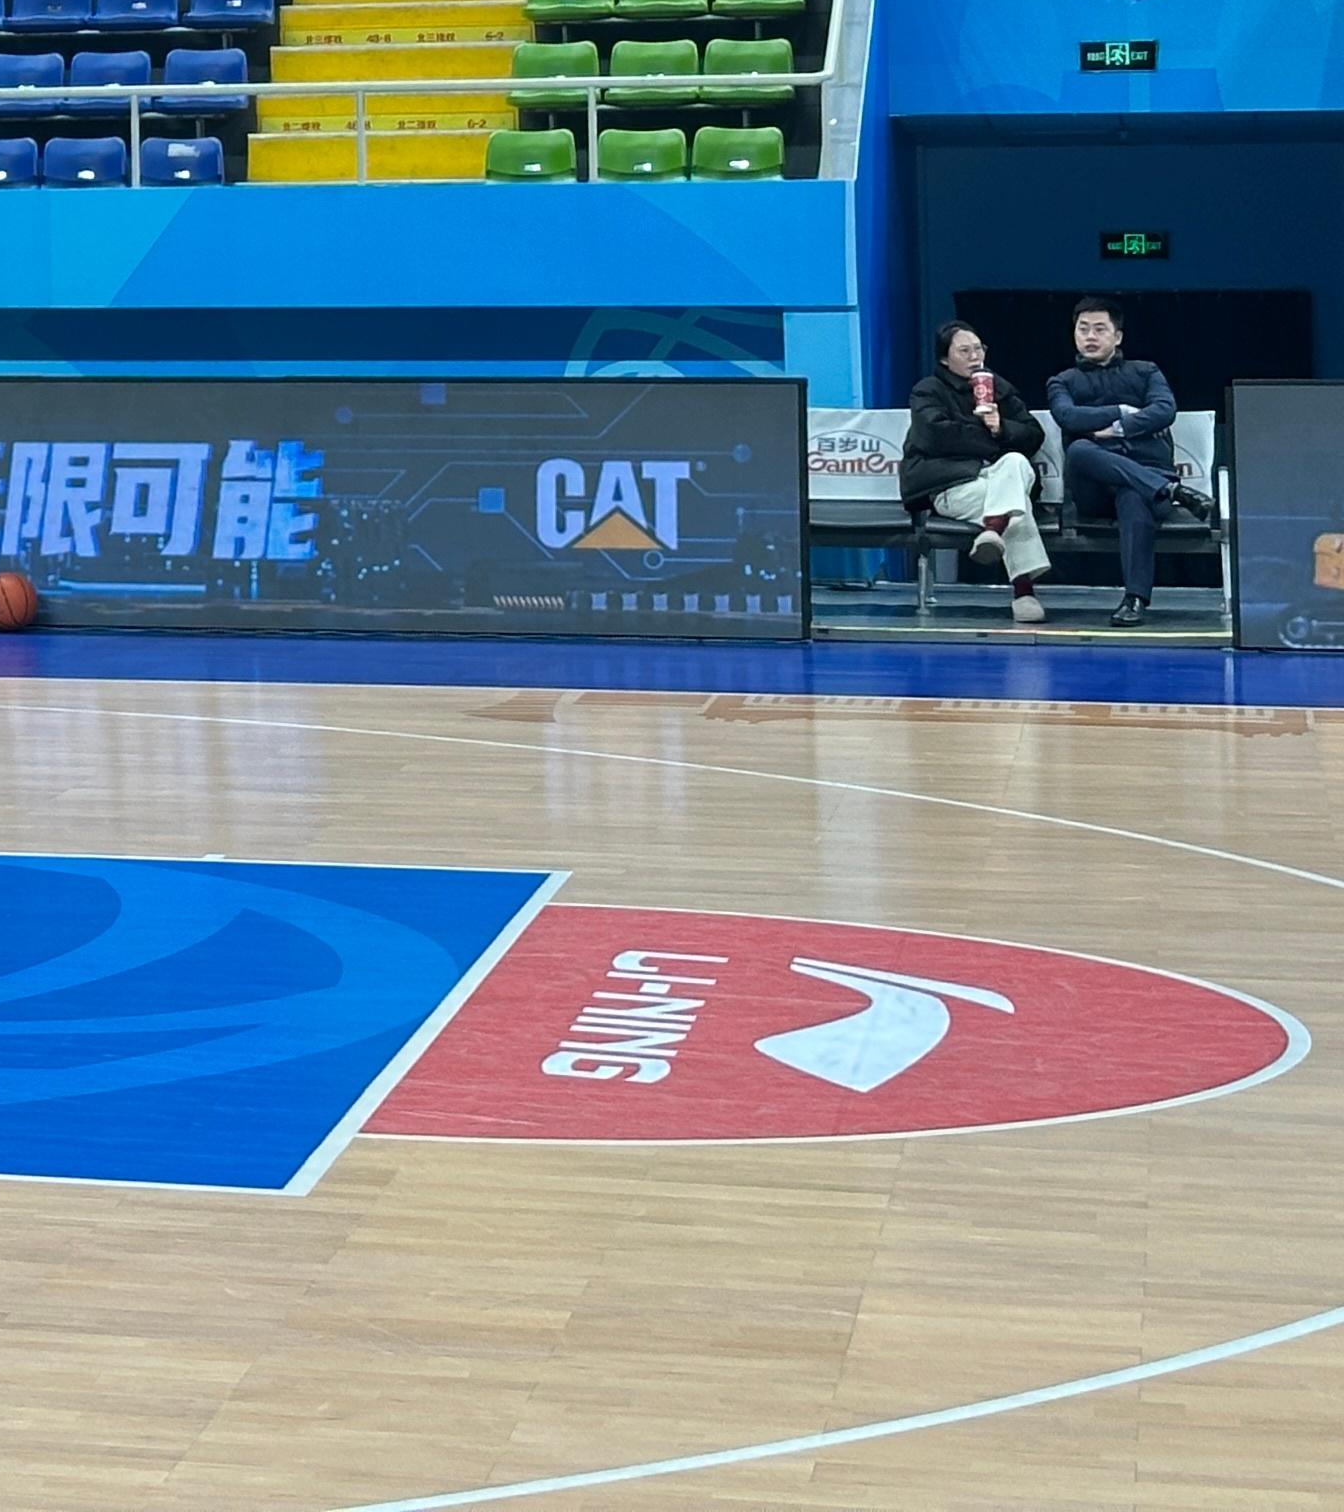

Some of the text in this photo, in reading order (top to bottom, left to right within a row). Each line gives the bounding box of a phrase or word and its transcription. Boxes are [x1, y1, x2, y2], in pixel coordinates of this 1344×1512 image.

[817, 436, 881, 455] 百岁山
[535, 457, 692, 551] CAT
[540, 949, 730, 1084] LI-NING
